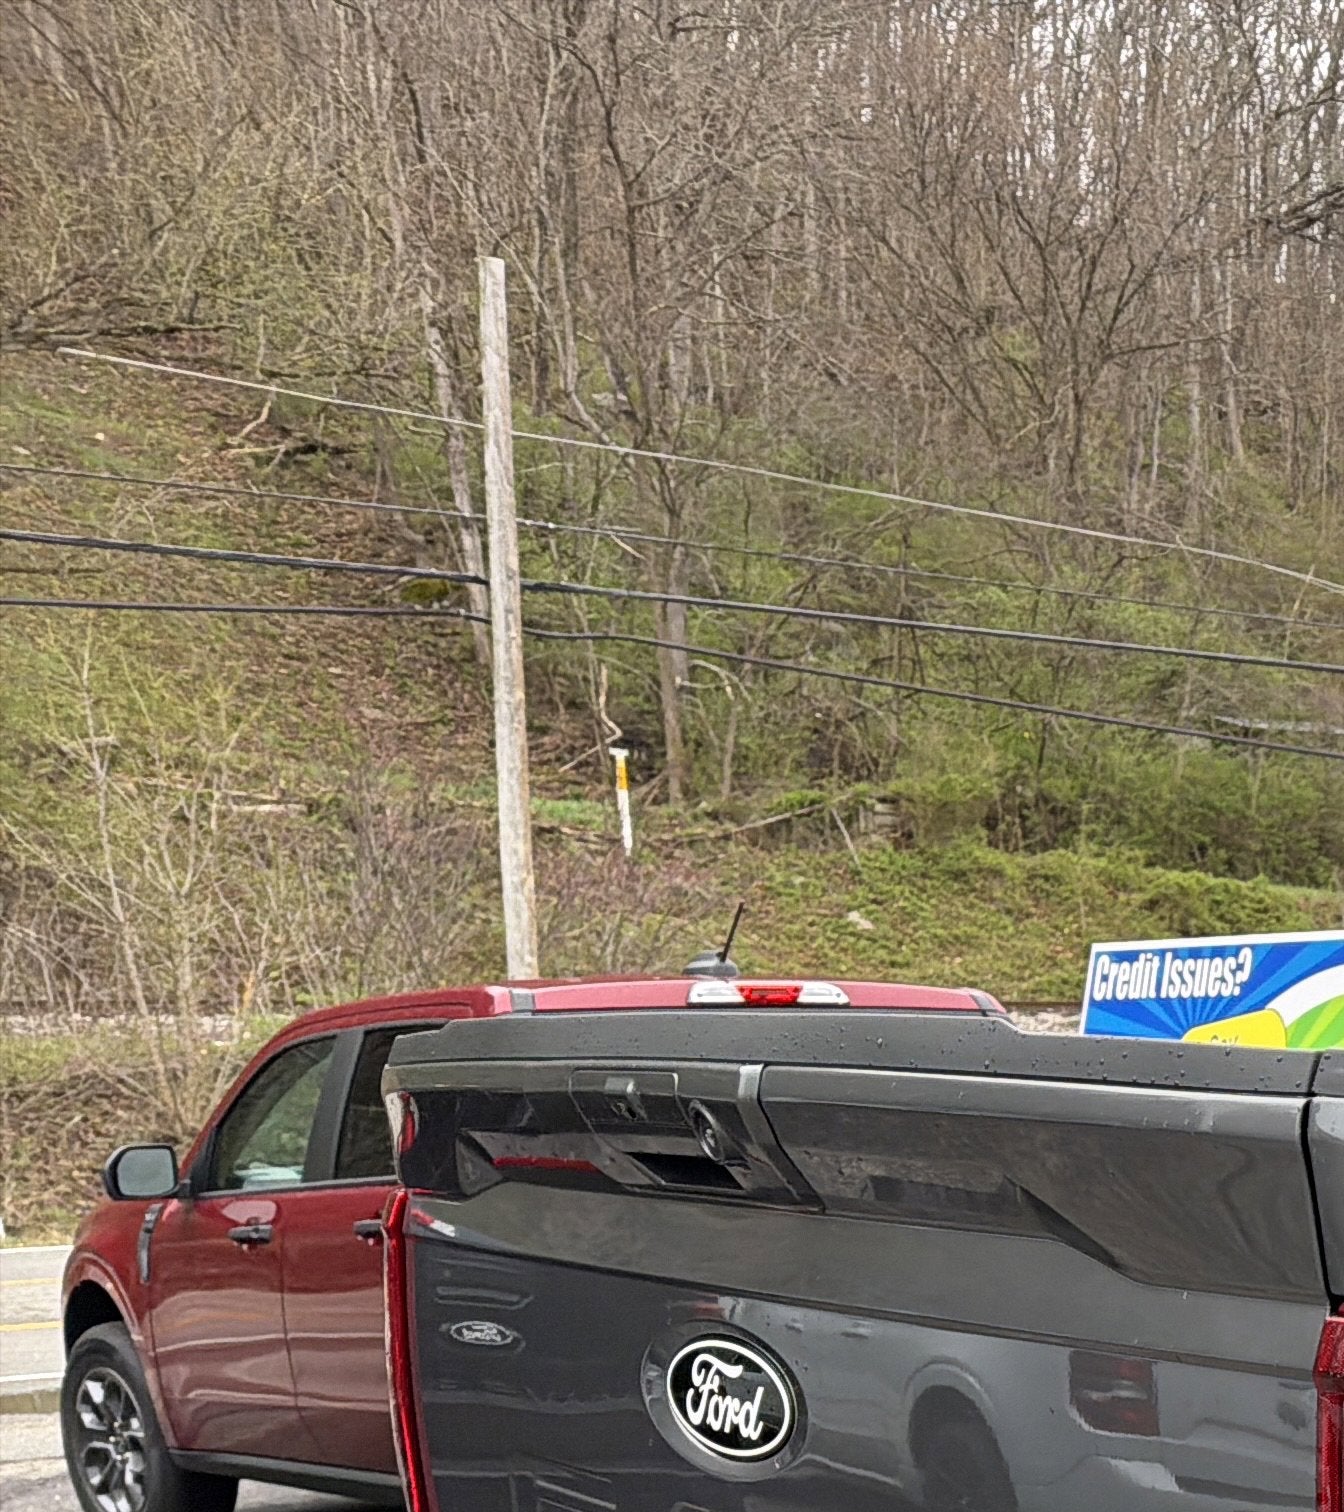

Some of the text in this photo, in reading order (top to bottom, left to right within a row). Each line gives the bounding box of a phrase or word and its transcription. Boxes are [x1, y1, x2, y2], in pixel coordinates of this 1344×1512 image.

[1093, 946, 1253, 1001] Credit Issues?
[685, 1353, 765, 1441] Ford
